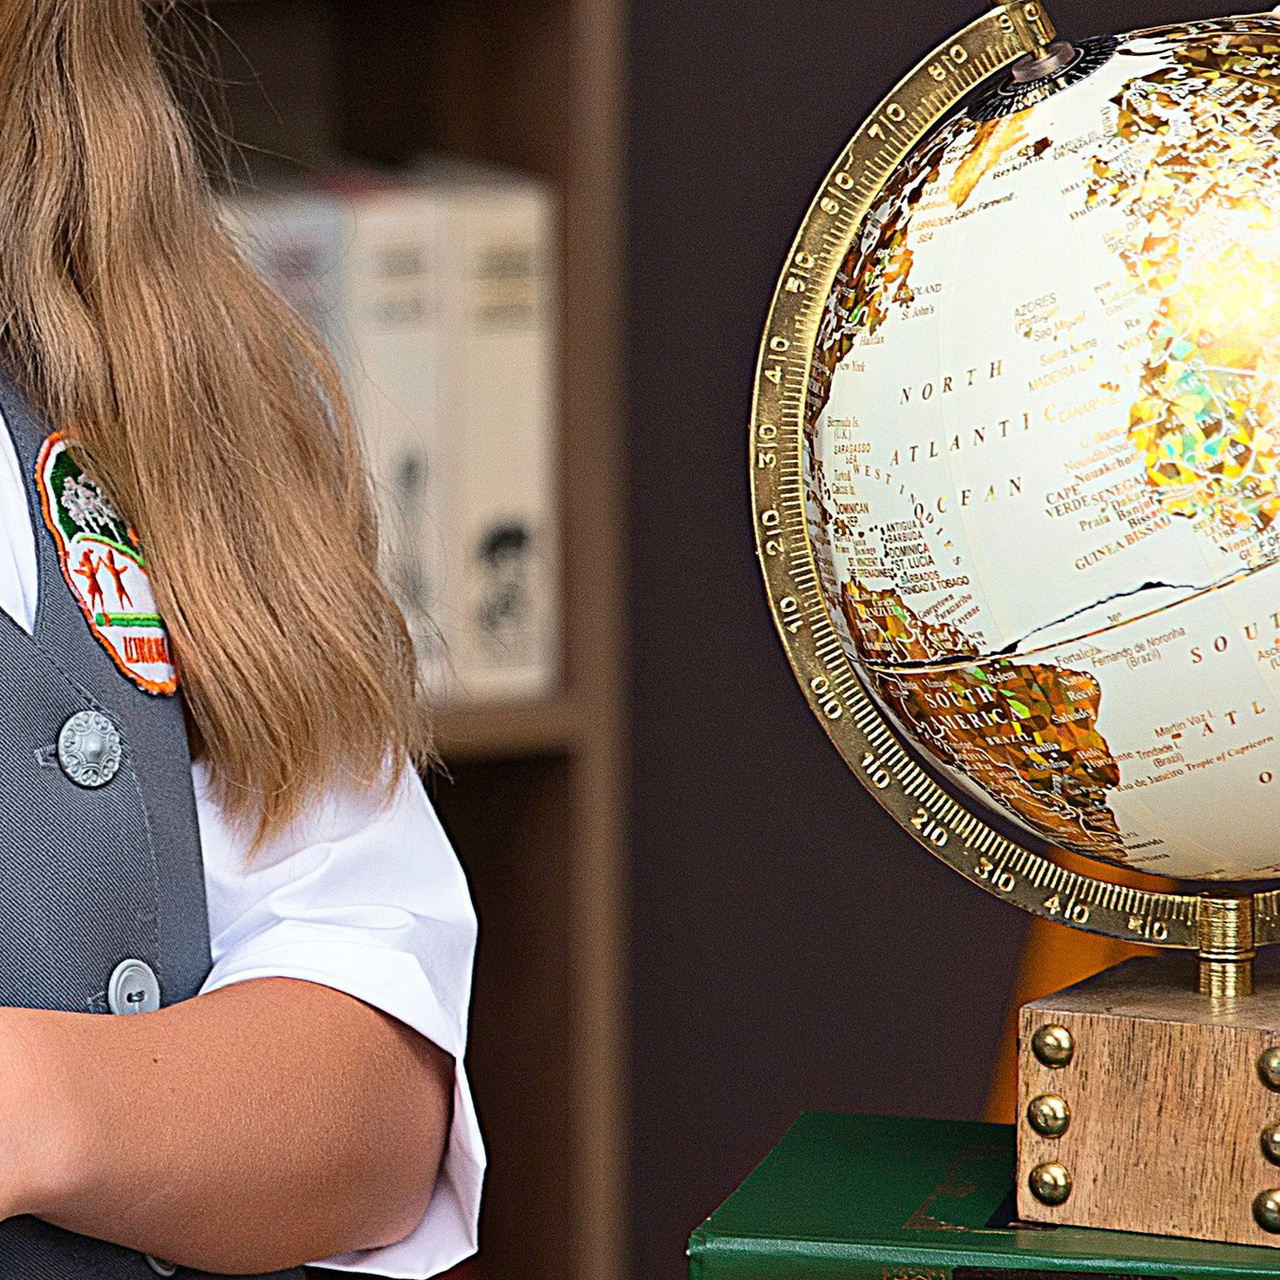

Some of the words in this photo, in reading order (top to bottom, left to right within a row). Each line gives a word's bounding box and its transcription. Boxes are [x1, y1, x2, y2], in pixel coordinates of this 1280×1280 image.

[1014, 292, 1057, 318] AZORES
[900, 358, 1002, 405] NORTH
[890, 403, 1057, 466] ATLANTIC
[852, 464, 892, 486] WEST
[914, 477, 1021, 522] OCEAN
[1045, 483, 1080, 506] CAPE
[1045, 496, 1091, 519] VERDE
[886, 520, 918, 533] ANTIGUA
[1079, 514, 1111, 532] Praia
[888, 531, 923, 544] BARBUDA
[1074, 540, 1125, 571] GUINEA
[1124, 515, 1172, 546] BISSAU
[889, 543, 930, 559] DOMINICA
[909, 555, 936, 569] LUCIA
[900, 571, 940, 585] BARBADOS
[900, 582, 929, 595] TRINIDAD
[938, 576, 969, 589] TOBAGO
[952, 605, 981, 628] Cayenne
[1092, 647, 1132, 668] Fernando
[1146, 627, 1186, 647] Noronha
[1127, 650, 1162, 671] (Brazil)
[986, 671, 1018, 685] Belem
[924, 685, 997, 709] SOUTH
[930, 706, 1032, 730] AMERICA
[1154, 720, 1187, 739] Martin
[1186, 713, 1206, 728] Vaz
[985, 732, 1032, 745] BRAZIL
[1136, 743, 1173, 760] Trindade
[1153, 752, 1185, 770] (Brazil)
[1185, 757, 1214, 773] Tropic
[1227, 735, 1274, 758] Capricorn
[1135, 778, 1148, 788] de
[1148, 768, 1184, 785] Janeiro
